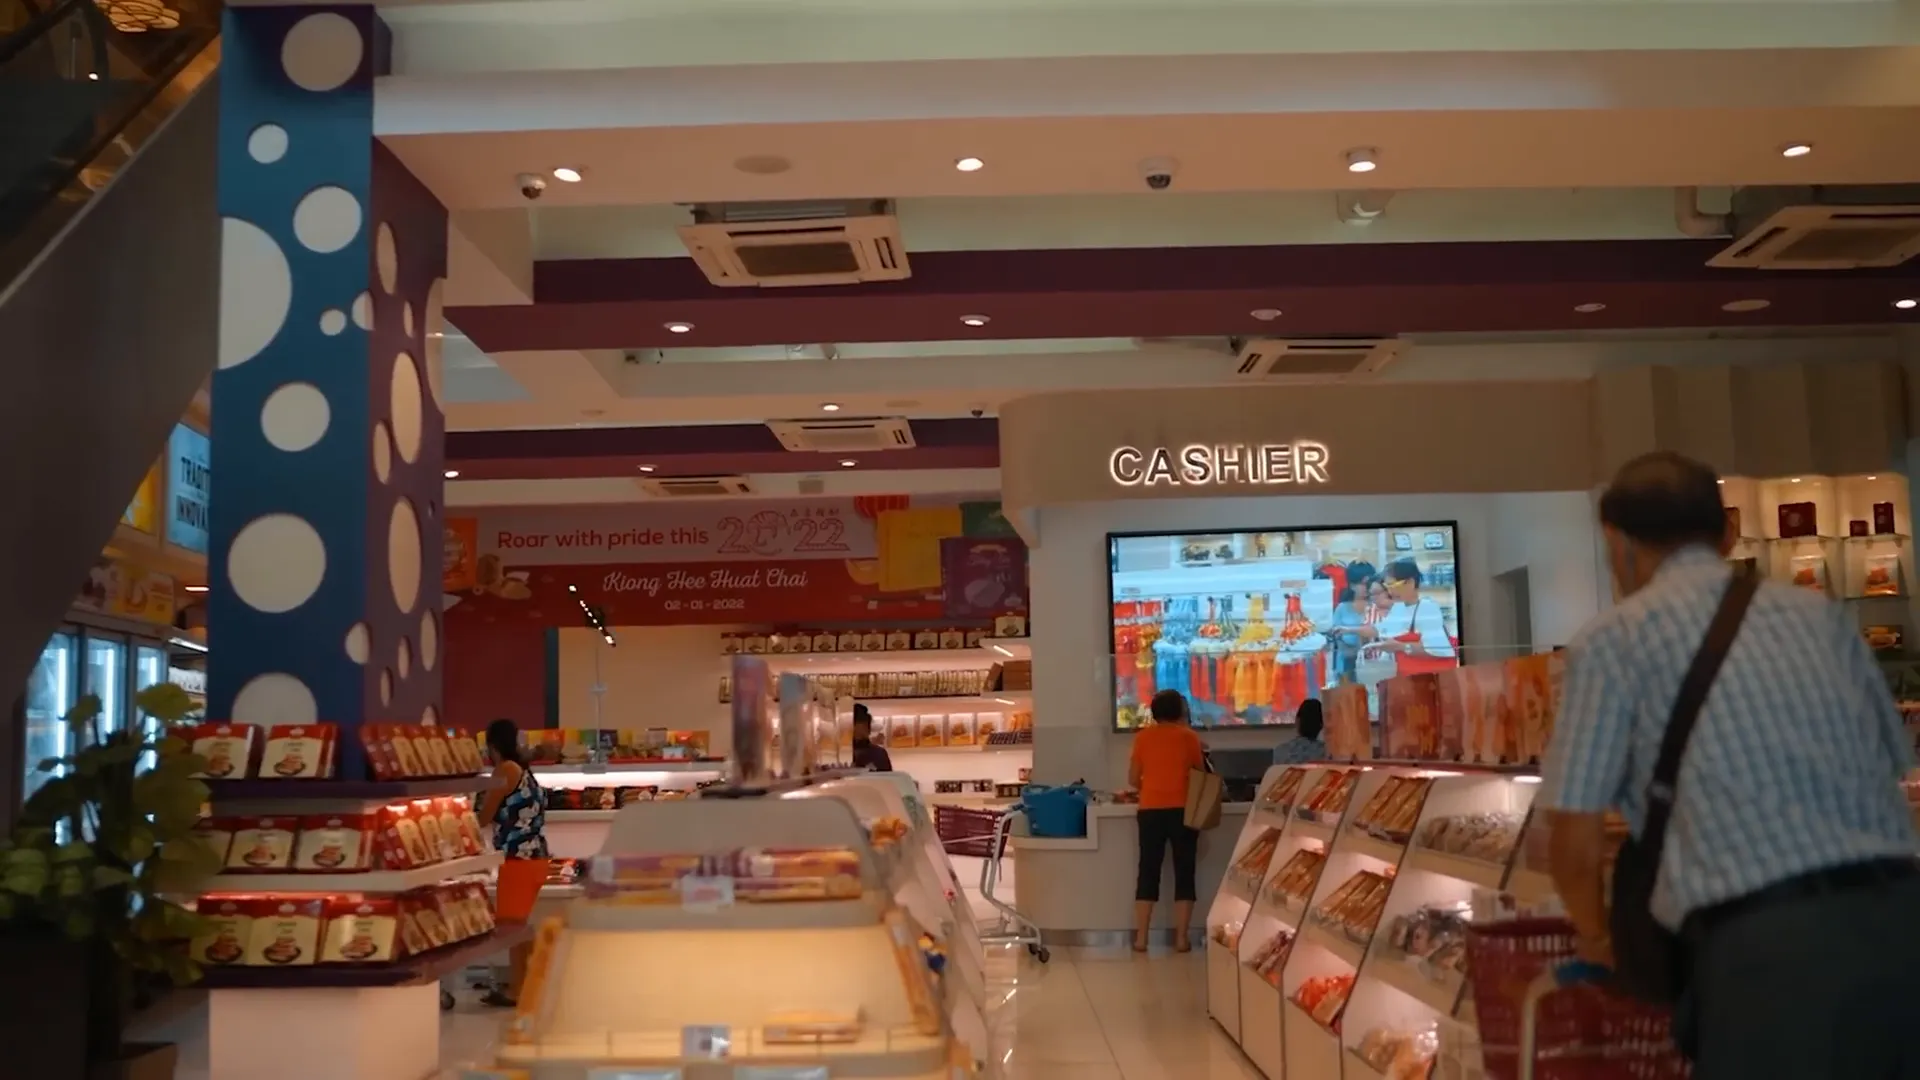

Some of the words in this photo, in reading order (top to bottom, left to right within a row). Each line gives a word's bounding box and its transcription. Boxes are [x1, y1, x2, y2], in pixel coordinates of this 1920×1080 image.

[1111, 441, 1328, 485] CASHIER
[498, 531, 548, 548] Roar
[555, 530, 602, 547] with
[607, 528, 664, 550] pride
[670, 527, 709, 544] this
[603, 572, 660, 597] Kiong
[667, 571, 705, 589] Hee
[710, 569, 760, 589] Huat
[766, 568, 808, 588] Chai
